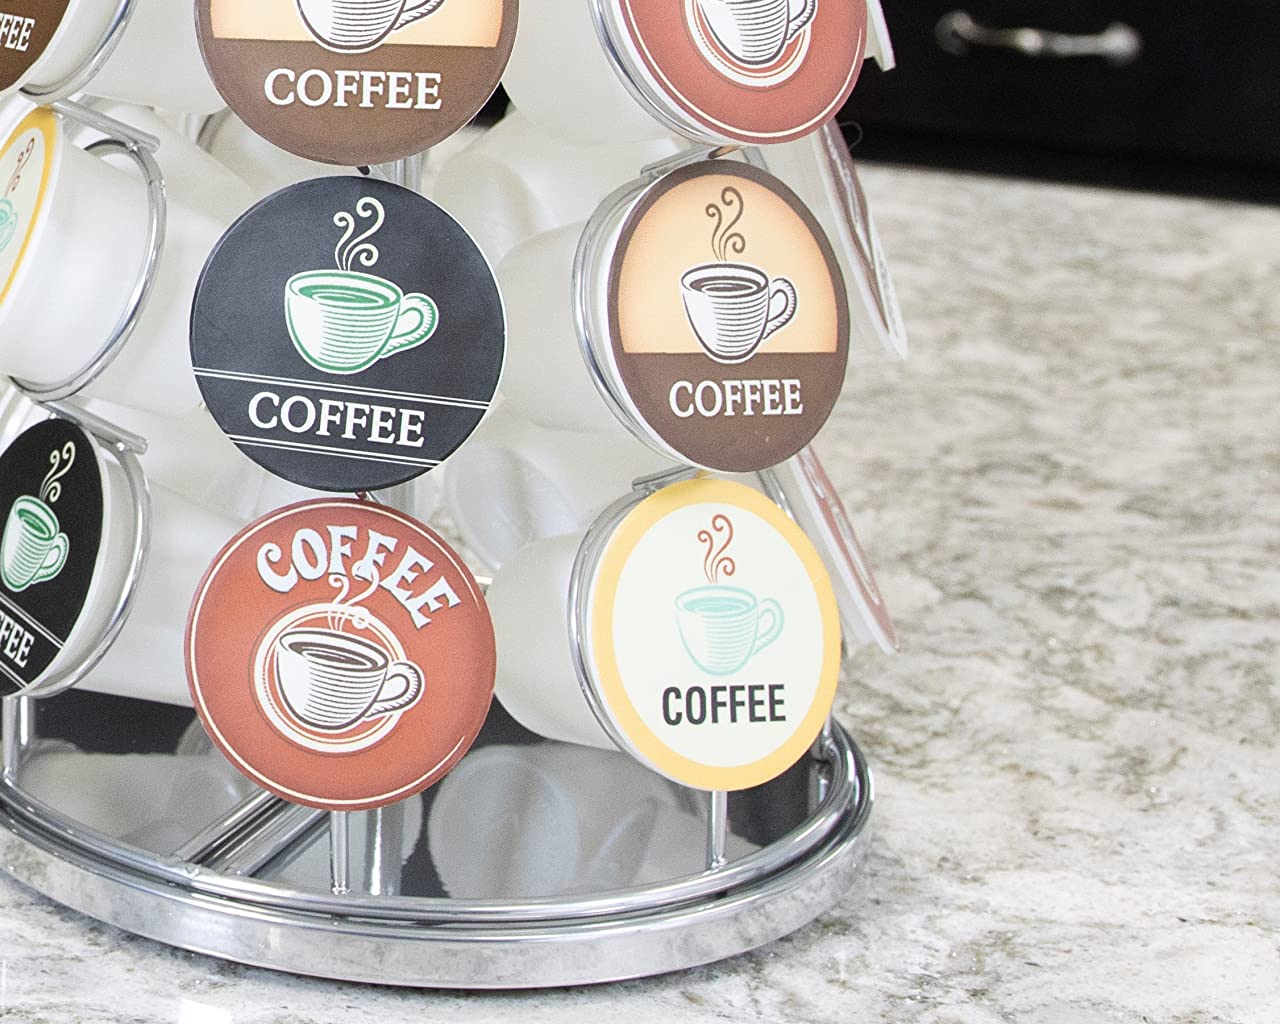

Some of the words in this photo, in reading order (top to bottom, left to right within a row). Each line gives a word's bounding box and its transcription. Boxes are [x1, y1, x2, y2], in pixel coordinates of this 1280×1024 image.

[264, 67, 443, 110] COFFEE
[248, 391, 425, 448] COFFEE
[669, 379, 803, 417] COFFEE
[256, 524, 462, 629] COFFEE
[662, 684, 786, 726] COFFEE
